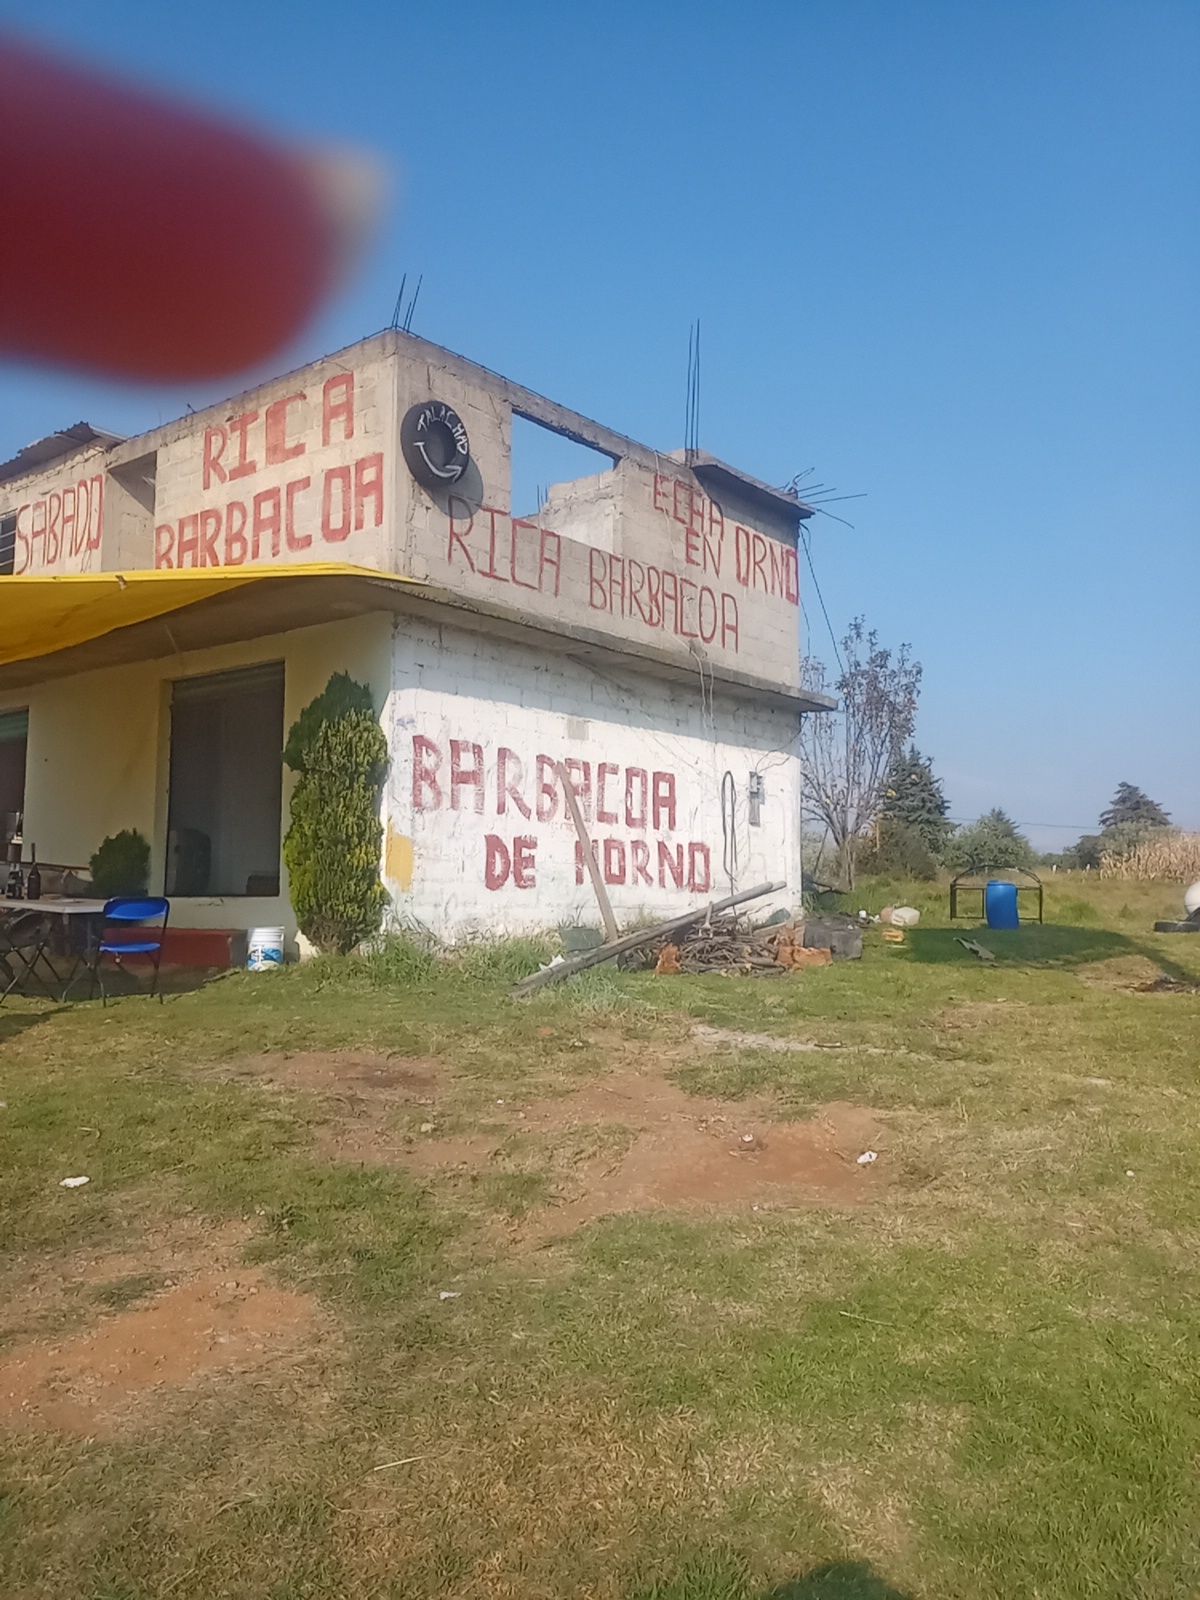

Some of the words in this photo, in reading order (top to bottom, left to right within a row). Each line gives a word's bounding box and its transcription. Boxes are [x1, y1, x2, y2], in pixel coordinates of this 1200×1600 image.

[203, 372, 354, 490] RICA
[16, 474, 104, 575] SABADO
[155, 453, 384, 569] BARBACOA
[654, 473, 724, 541] ECHA
[448, 495, 562, 598] RICA
[590, 548, 739, 654] BARBACOA
[685, 527, 723, 579] EN
[735, 525, 799, 606] ORNO
[412, 734, 677, 831] BARBACOA
[485, 834, 538, 891] DE
[574, 838, 711, 893] HORNO
